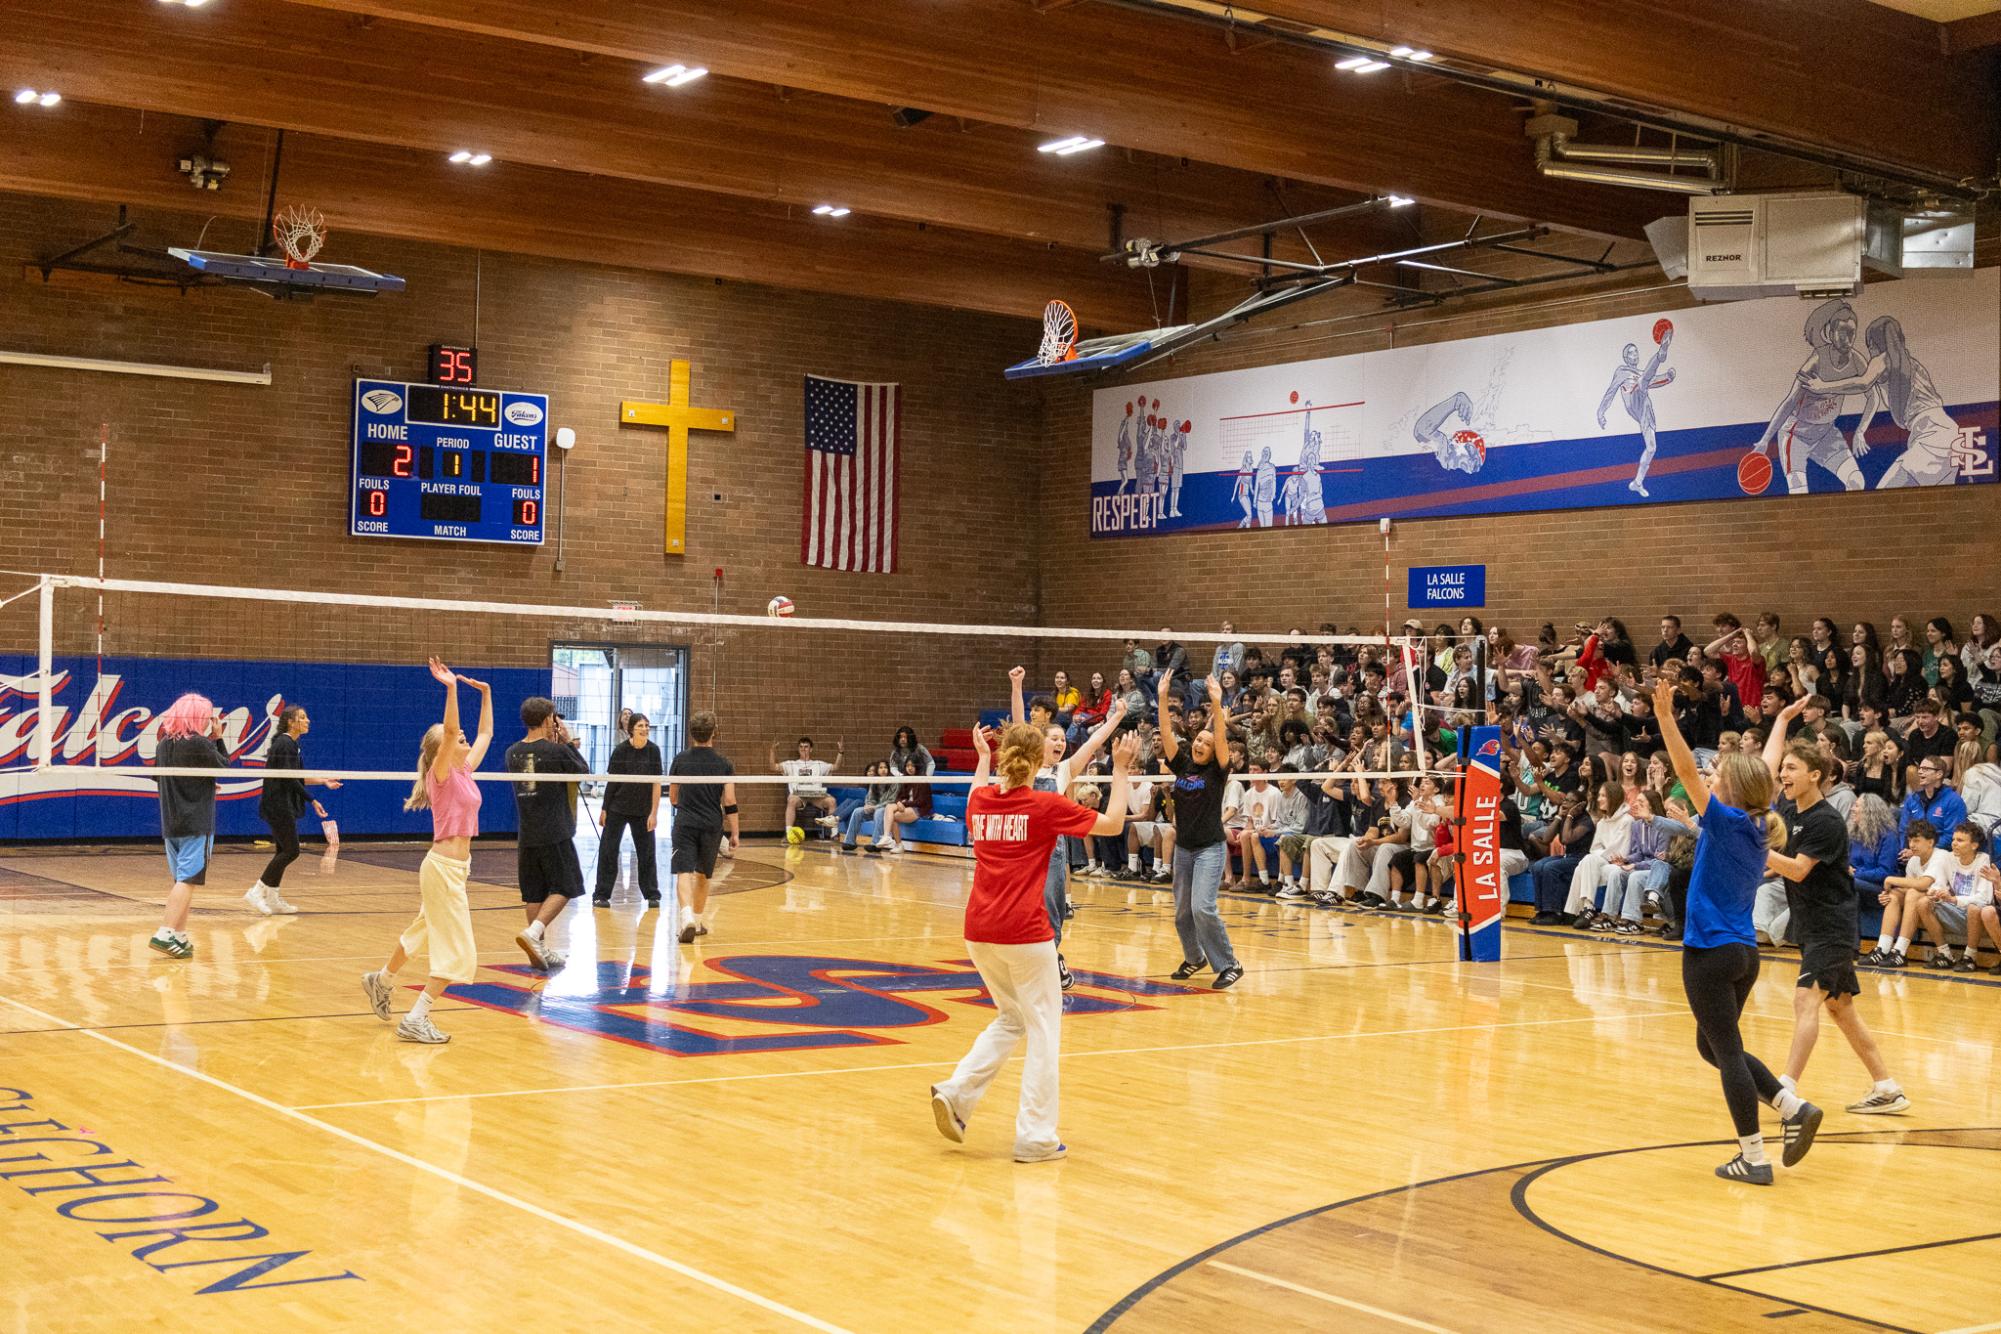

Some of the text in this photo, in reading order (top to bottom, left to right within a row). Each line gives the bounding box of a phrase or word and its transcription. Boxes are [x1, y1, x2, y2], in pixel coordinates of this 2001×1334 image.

[1705, 253, 1742, 263] REZNOR
[439, 350, 473, 383] 35
[443, 392, 497, 424] 1:44
[367, 423, 409, 441] HOME
[436, 436, 470, 449] PERIOD
[494, 433, 538, 450] GUEST
[393, 444, 413, 477] 2
[453, 453, 461, 476] 1
[531, 456, 540, 484] 1
[359, 477, 390, 491] FOULS
[420, 482, 483, 497] PLAYER FOUL
[511, 487, 541, 500] FOULS
[369, 491, 385, 516] 0
[521, 500, 536, 525] 0
[1093, 493, 1160, 532] RESPECT
[357, 520, 389, 532] SCORE
[434, 524, 467, 537] MATCH
[510, 529, 540, 541] SCORE
[1426, 572, 1466, 586] LA SALLE
[1426, 587, 1465, 600] FALCONS
[986, 814, 1004, 841] WITH
[1003, 814, 1030, 842] HEART
[1473, 795, 1499, 901] LA SALLE
[0, 1087, 367, 1295] EGHORN
